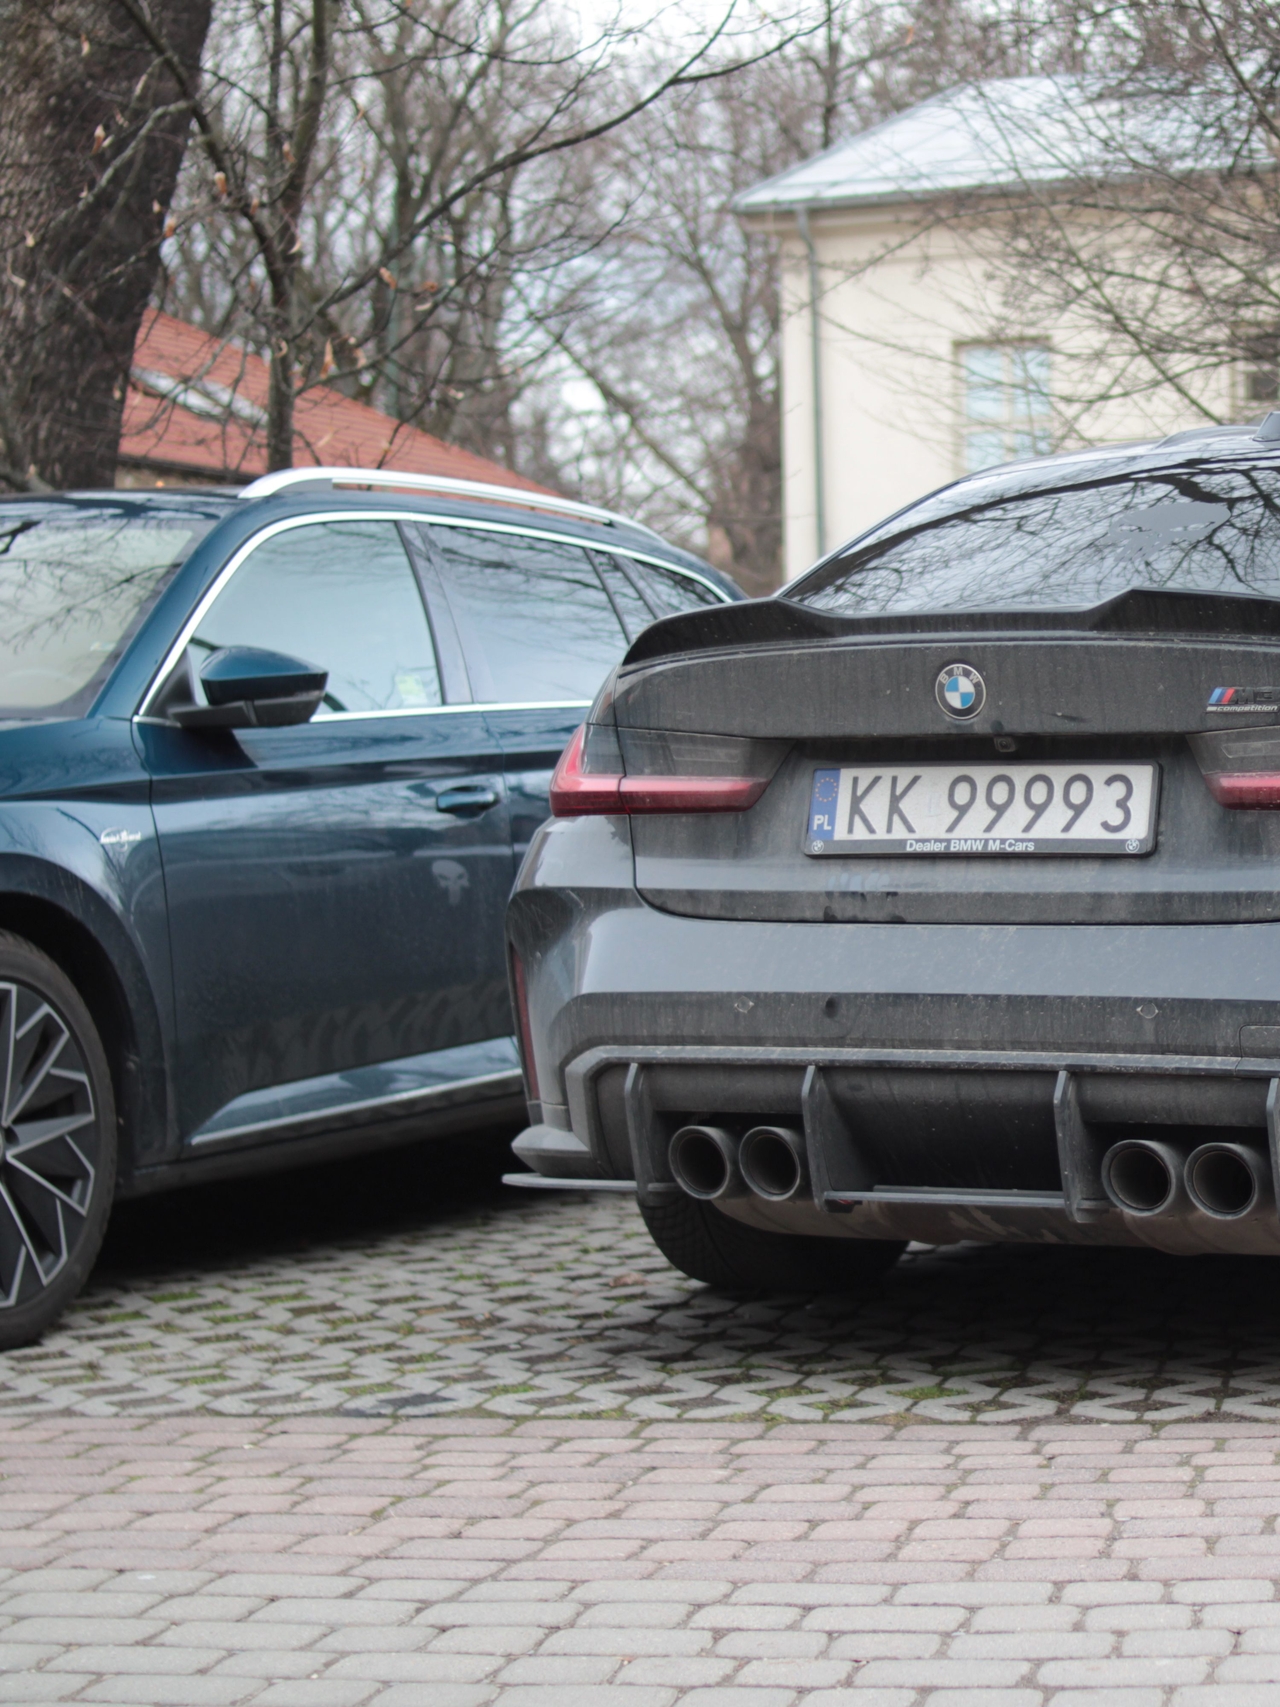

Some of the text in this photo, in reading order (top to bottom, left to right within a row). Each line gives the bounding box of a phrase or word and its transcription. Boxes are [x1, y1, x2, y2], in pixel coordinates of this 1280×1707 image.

[939, 666, 980, 685] BMW
[1217, 704, 1279, 712] competition
[846, 772, 1135, 836] KK 99993
[813, 815, 832, 831] PL
[906, 839, 1035, 852] Dealer BMW M-Cars
